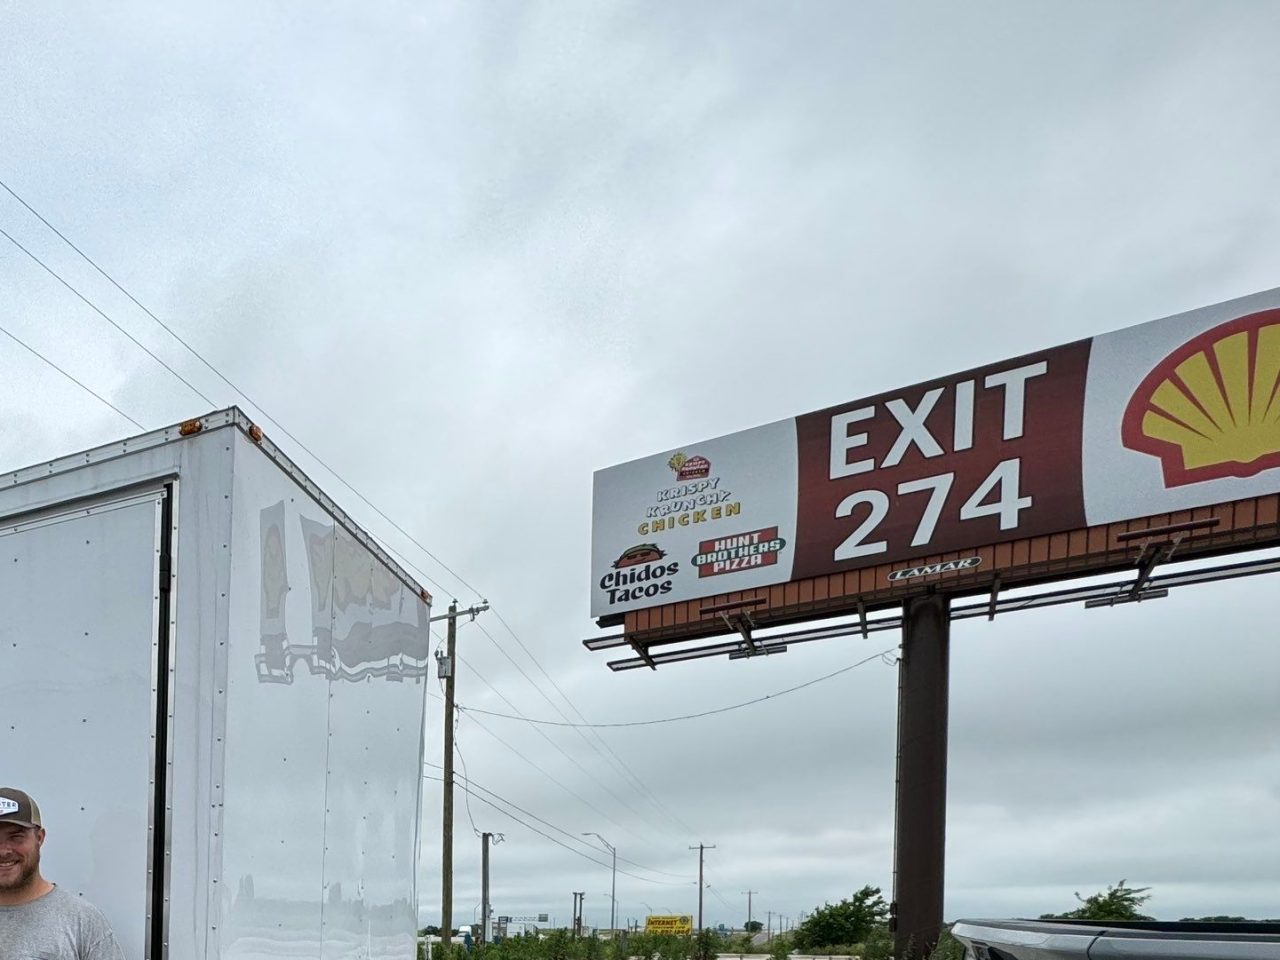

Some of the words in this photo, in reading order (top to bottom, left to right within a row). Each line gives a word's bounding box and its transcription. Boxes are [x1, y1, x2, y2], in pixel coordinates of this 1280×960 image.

[829, 360, 1048, 480] EXIT
[657, 477, 721, 502] KRISPY
[646, 490, 732, 518] KRUNCHY
[833, 457, 1033, 562] 274
[637, 502, 741, 536] CHICKEN
[696, 539, 781, 566] BROTHERS
[714, 532, 762, 551] HUNT
[599, 561, 679, 590] Chidos
[713, 554, 762, 573] PIZZA
[895, 559, 972, 580] LAMAR
[606, 579, 673, 605] Tacos
